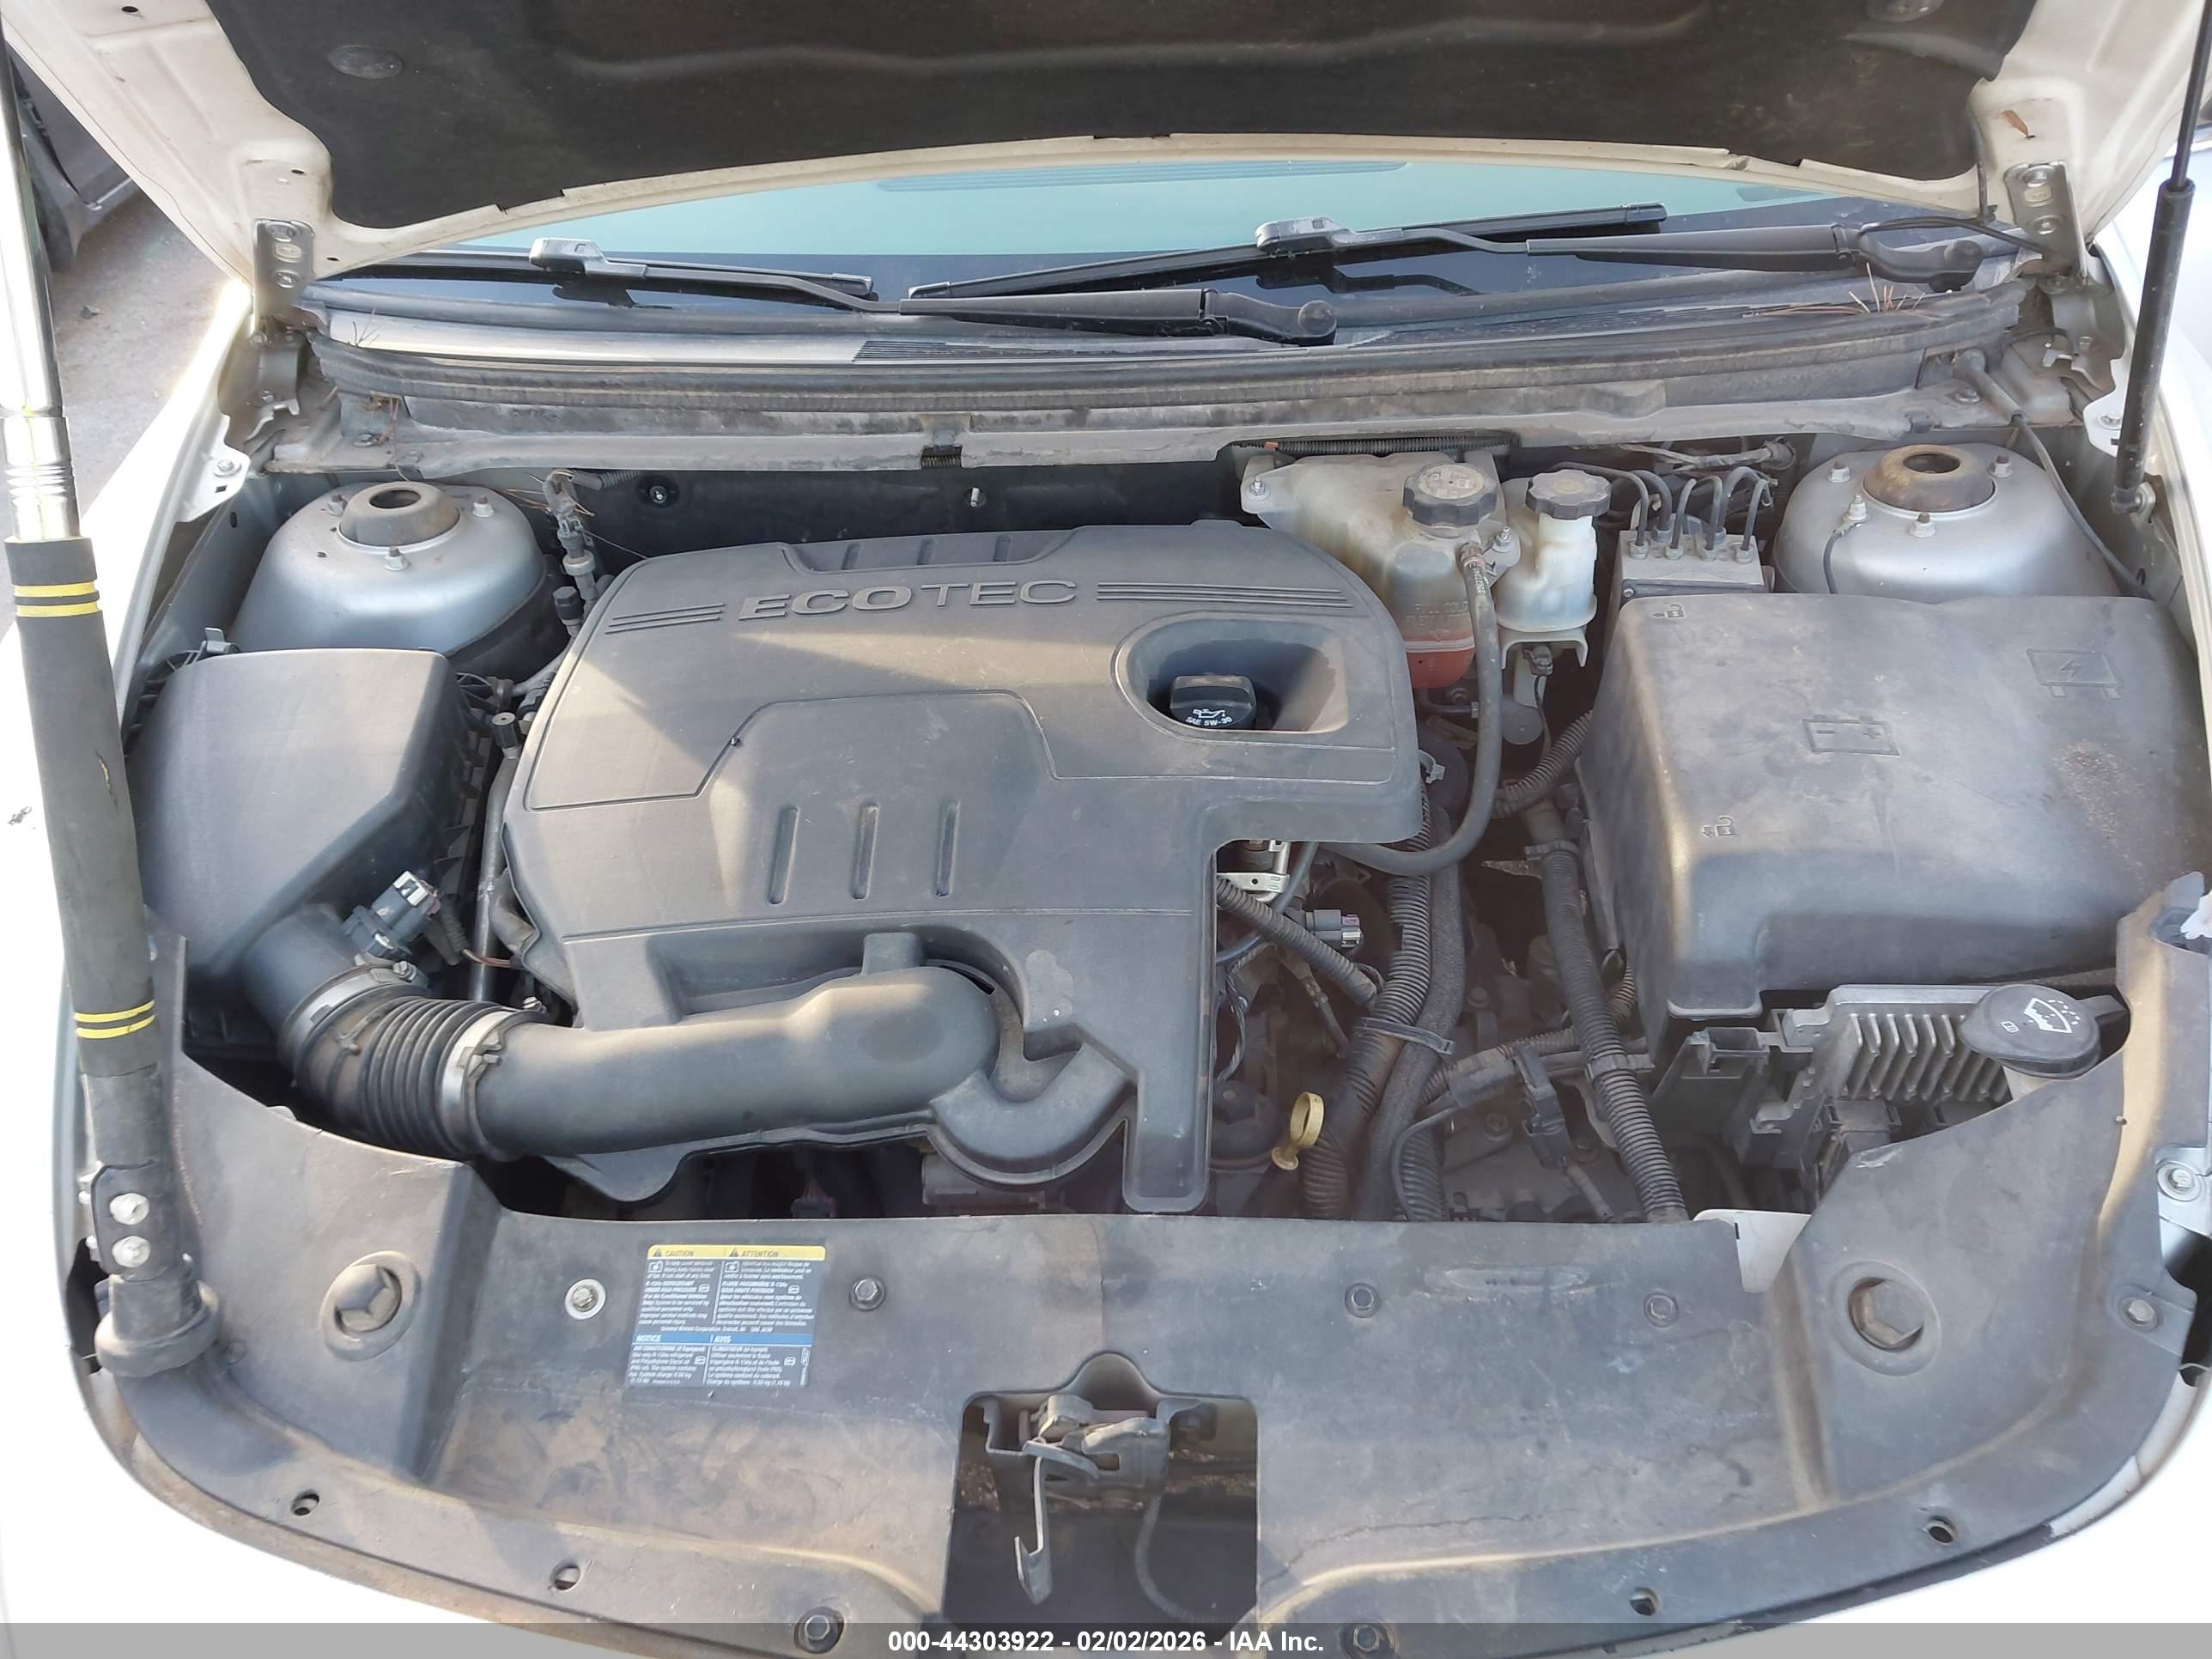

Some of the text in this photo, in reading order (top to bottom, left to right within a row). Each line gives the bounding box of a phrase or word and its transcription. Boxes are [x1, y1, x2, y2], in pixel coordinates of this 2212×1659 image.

[738, 580, 1077, 621] ECOTEC
[1185, 716, 1232, 726] SAE 5W-30
[741, 1249, 779, 1258] ATTENTION
